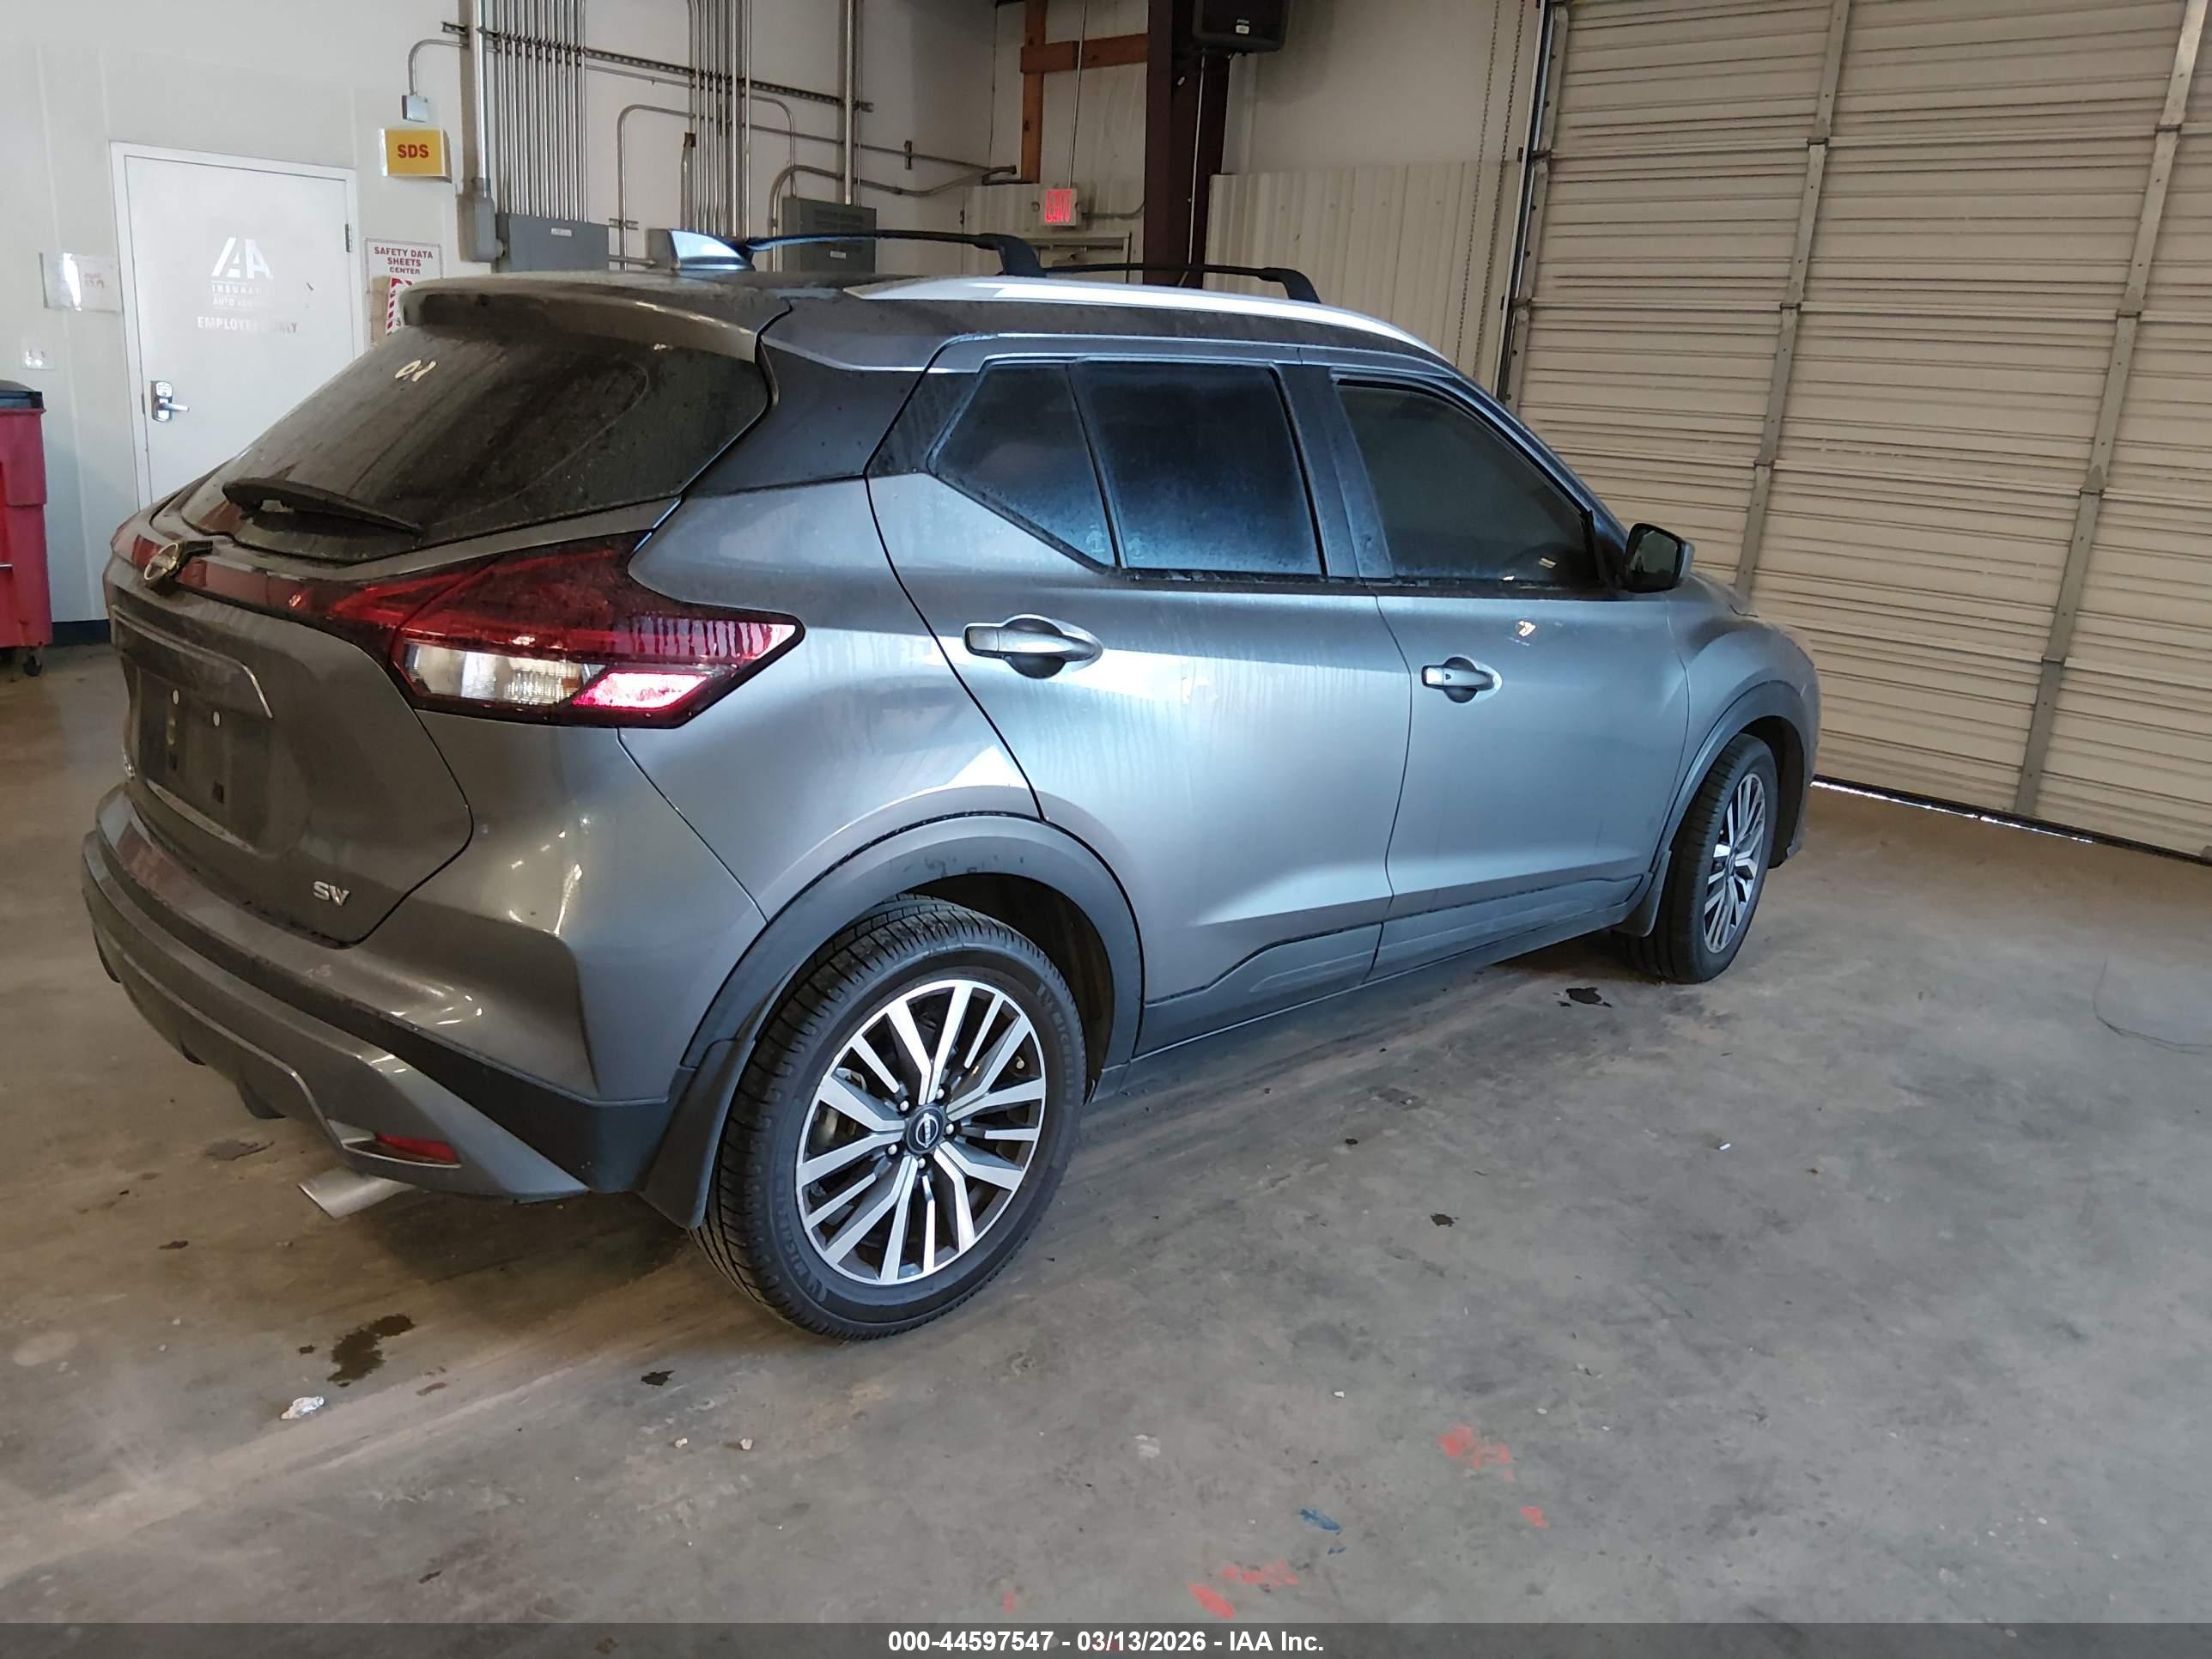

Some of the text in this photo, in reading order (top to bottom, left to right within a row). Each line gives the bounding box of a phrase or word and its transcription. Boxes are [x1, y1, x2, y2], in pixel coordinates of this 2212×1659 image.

[397, 143, 429, 159] SDS
[374, 246, 433, 259] SAFETY DATA
[387, 258, 422, 267] SHEETS
[389, 266, 421, 275] CENTER
[313, 880, 350, 907] SV
